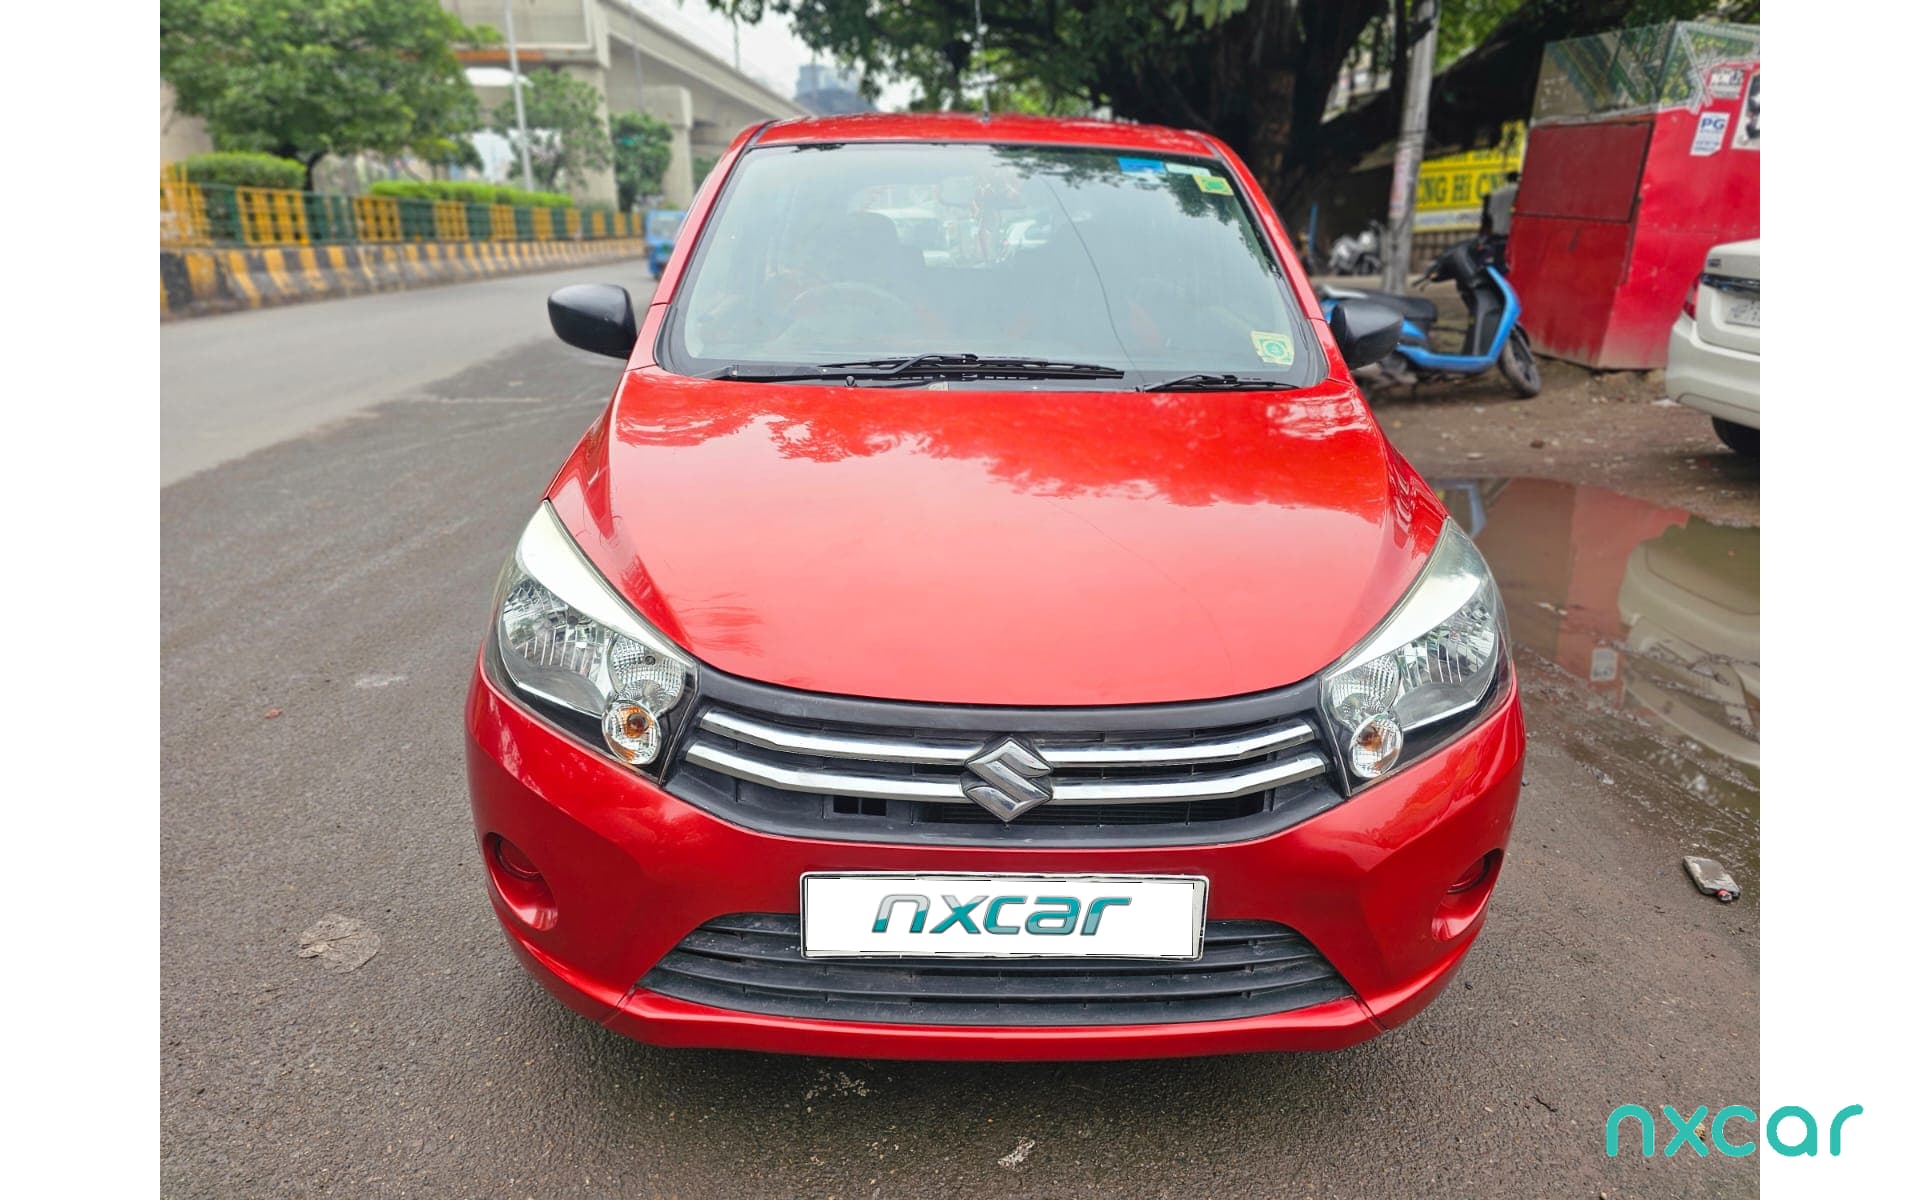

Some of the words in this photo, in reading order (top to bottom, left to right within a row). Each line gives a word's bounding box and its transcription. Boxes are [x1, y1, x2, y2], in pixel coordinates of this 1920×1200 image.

[1701, 117, 1726, 130] PG
[1416, 176, 1447, 203] NG
[1476, 171, 1508, 199] CN
